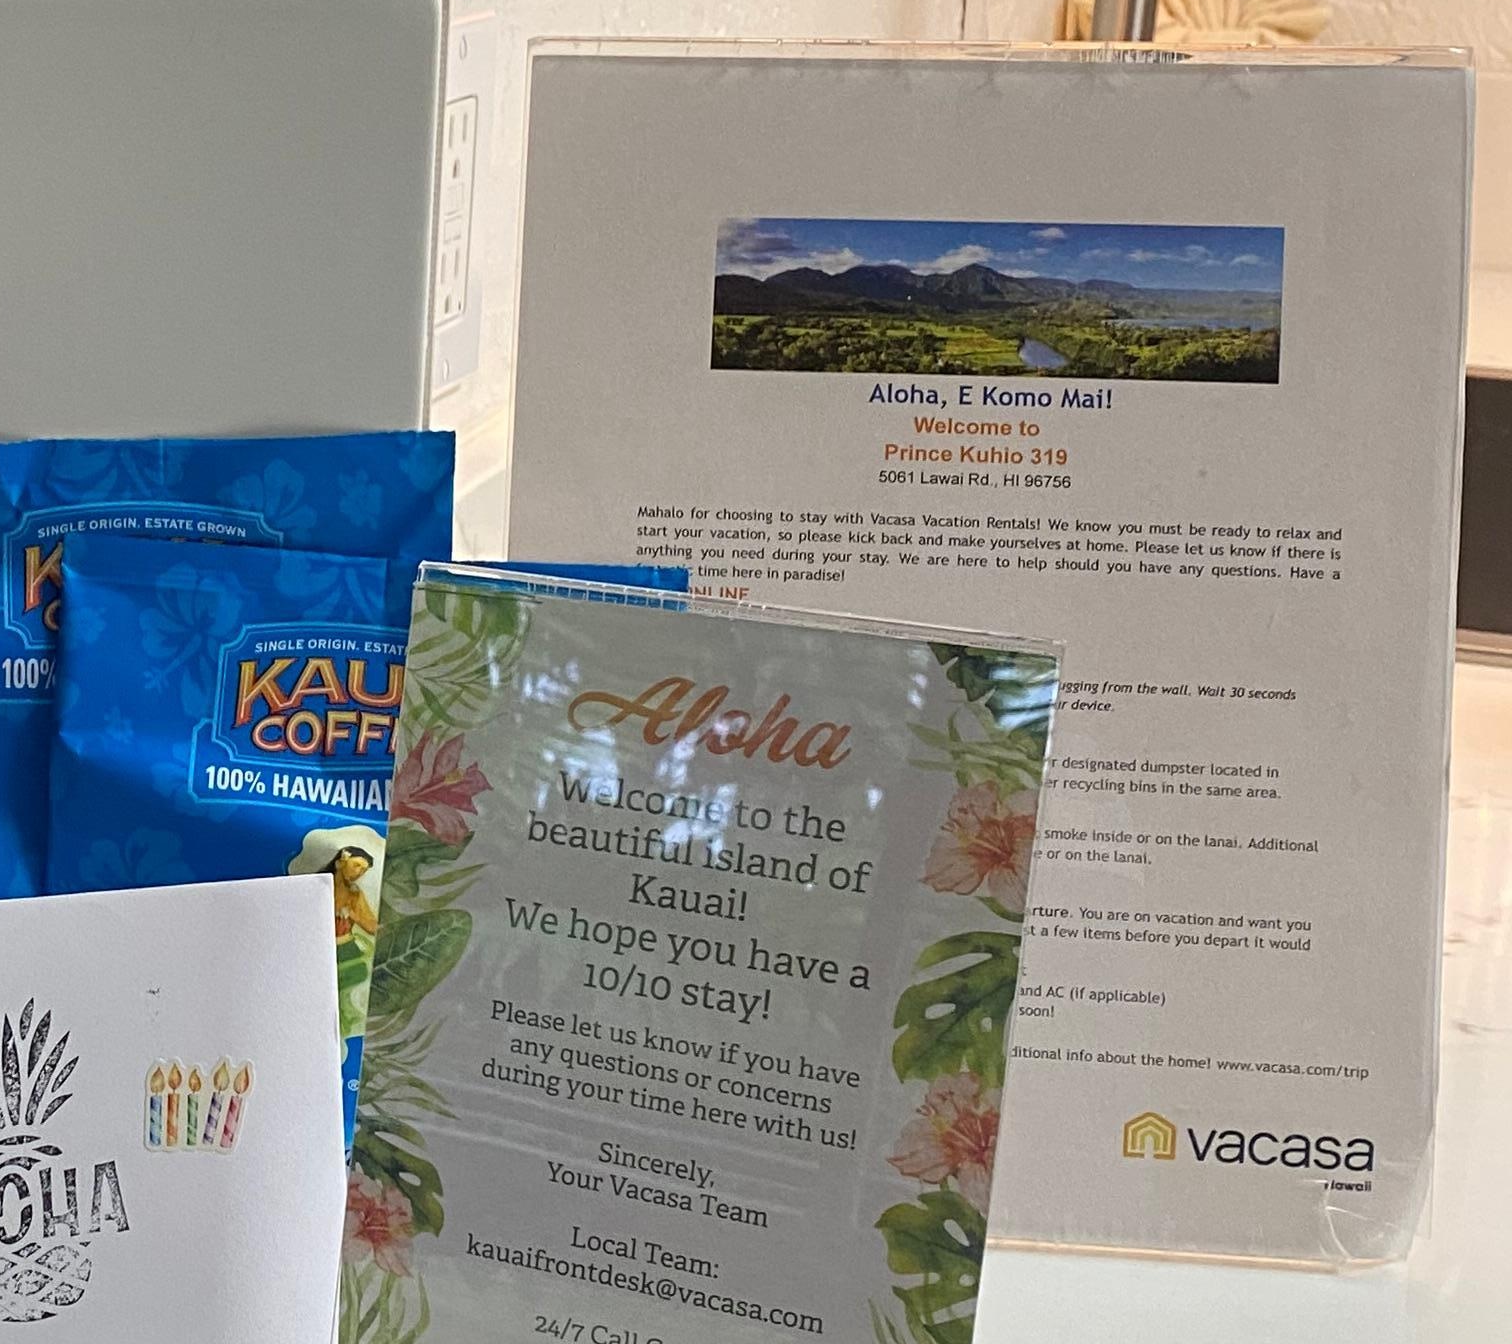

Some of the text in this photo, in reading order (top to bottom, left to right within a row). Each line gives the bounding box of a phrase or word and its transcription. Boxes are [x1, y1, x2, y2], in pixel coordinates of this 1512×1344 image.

[868, 382, 1111, 409] Aloha, E Komo Mai!
[914, 416, 1039, 436] Welcome to
[884, 443, 1067, 465] Prince Kuhio 319
[878, 470, 913, 483] 5061
[920, 471, 963, 485] Lawai
[1003, 473, 1019, 486] HI
[1024, 474, 1070, 488] 96756
[38, 517, 247, 538] SINGLE ORIGIN. ESTATE GROWN
[637, 505, 1040, 530] Mahalo for choosing to stay with Vacasa Vacation Rentals!
[254, 637, 304, 653] SINGLE
[307, 638, 359, 652] ORIGIN.
[568, 675, 853, 770] Aloha
[205, 766, 266, 794] 100%
[560, 769, 845, 842] Welcome to the
[527, 809, 872, 893] beautiful island of
[628, 873, 746, 921] Kauai!
[505, 897, 870, 990] We hope you have a
[583, 963, 770, 1024] 10/10 stay!
[490, 999, 859, 1087] Please let us know if you have
[1066, 1048, 1092, 1061] info
[1096, 1050, 1136, 1064] about
[1140, 1053, 1163, 1066] the
[1168, 1054, 1210, 1069] home!
[1216, 1060, 1368, 1081] www.vacasa.com/trip
[510, 1038, 831, 1113] any questions or concerns
[481, 1057, 856, 1150] during your time here with us!
[598, 1142, 714, 1189] Sincerely,
[1187, 1128, 1373, 1171] vacasa
[547, 1160, 767, 1228] Your Vacasa Team
[570, 1226, 718, 1278] Local Team:
[466, 1233, 822, 1334] kauaifrontdesk@vacasa.com
[534, 1315, 584, 1342] 24/7
